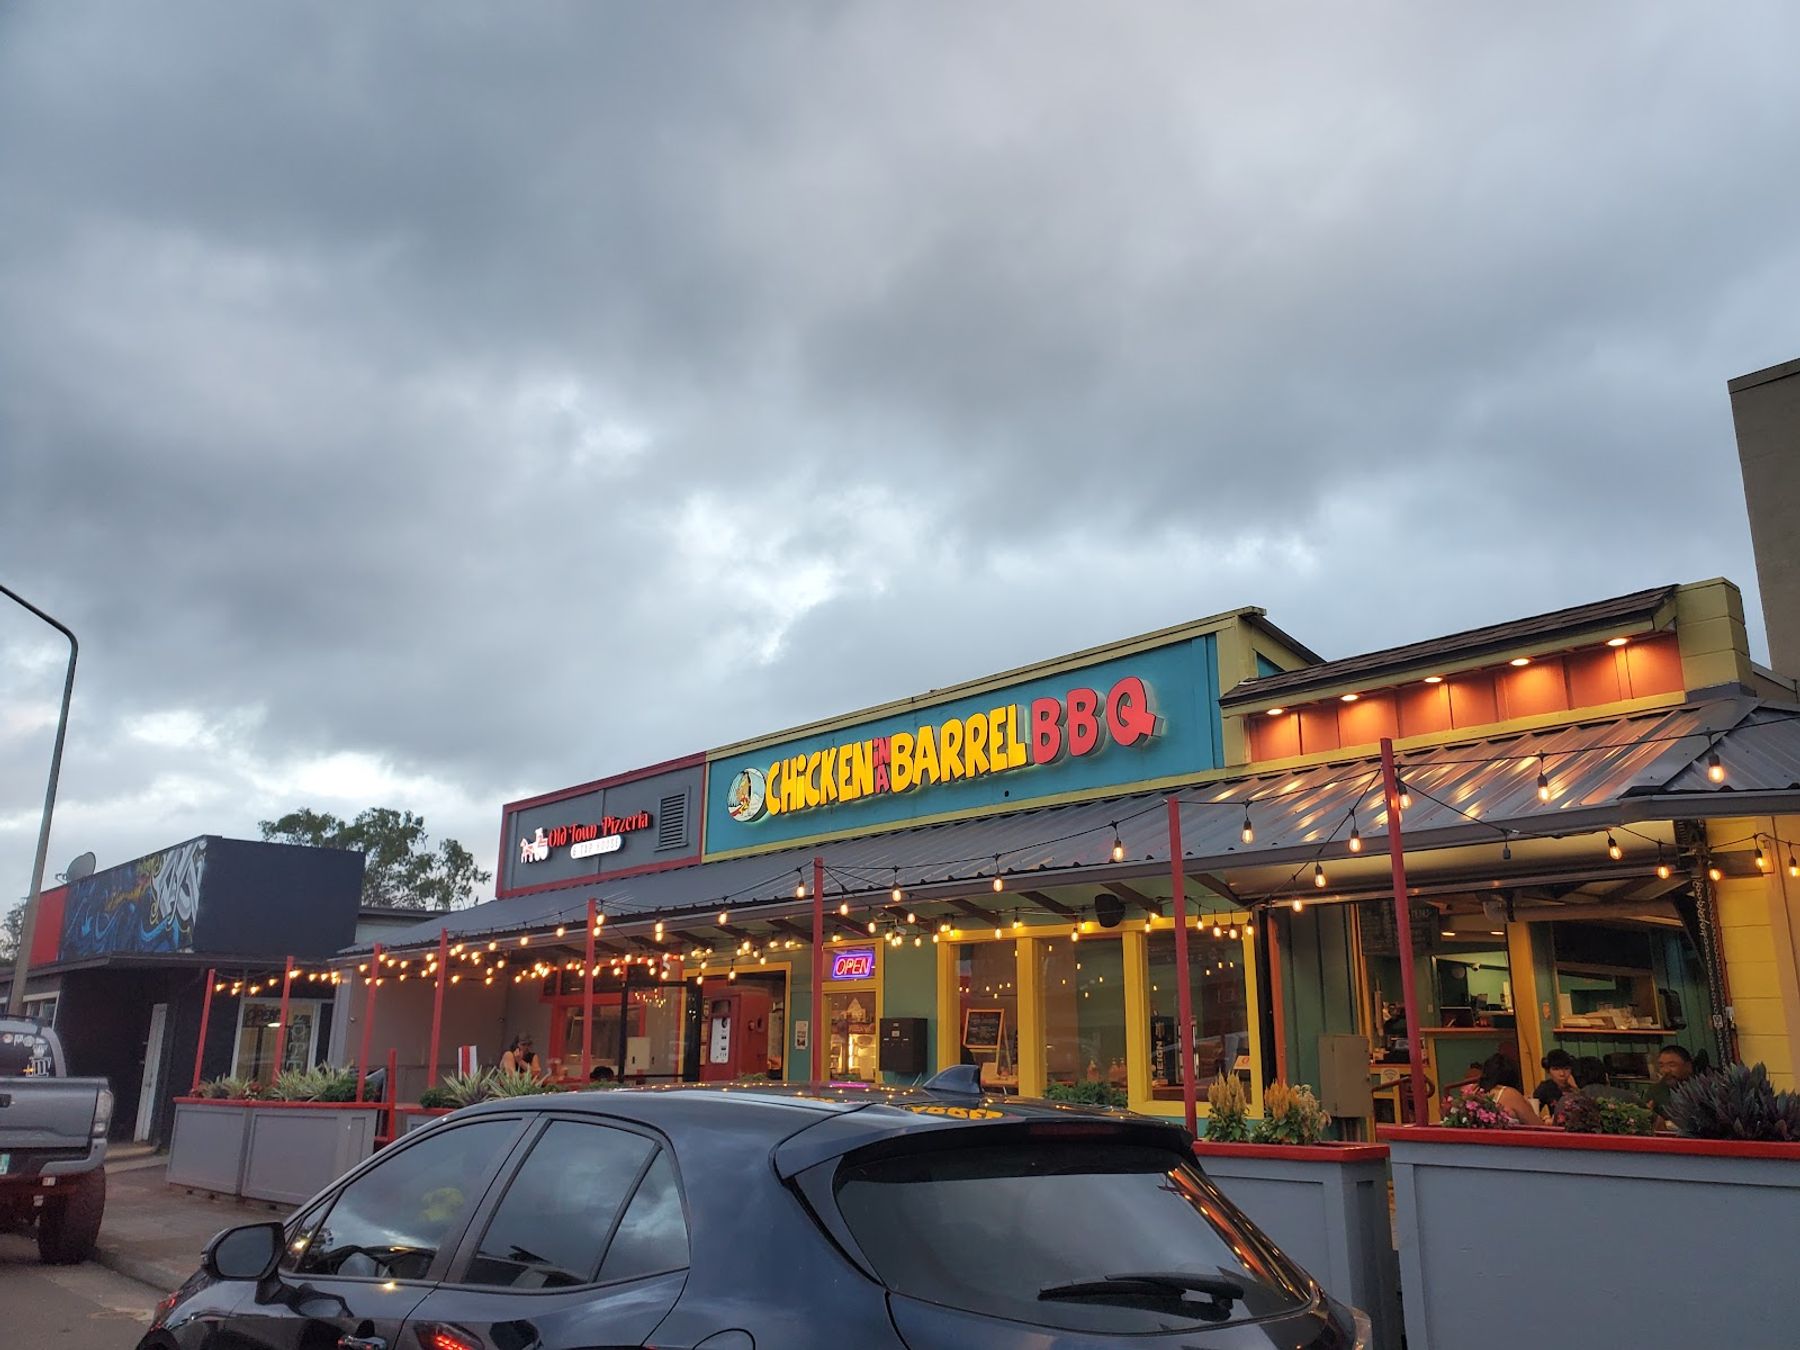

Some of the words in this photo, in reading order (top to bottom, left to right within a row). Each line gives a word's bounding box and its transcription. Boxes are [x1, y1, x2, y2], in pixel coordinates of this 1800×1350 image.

[891, 703, 1027, 793] BARREL
[1031, 676, 1157, 765] BBQ
[875, 763, 889, 793] A
[548, 825, 567, 847] Old
[569, 823, 597, 843] Town
[602, 810, 648, 836] Pizzeria
[836, 957, 870, 976] OPEN
[1155, 1040, 1165, 1079] REIGN
